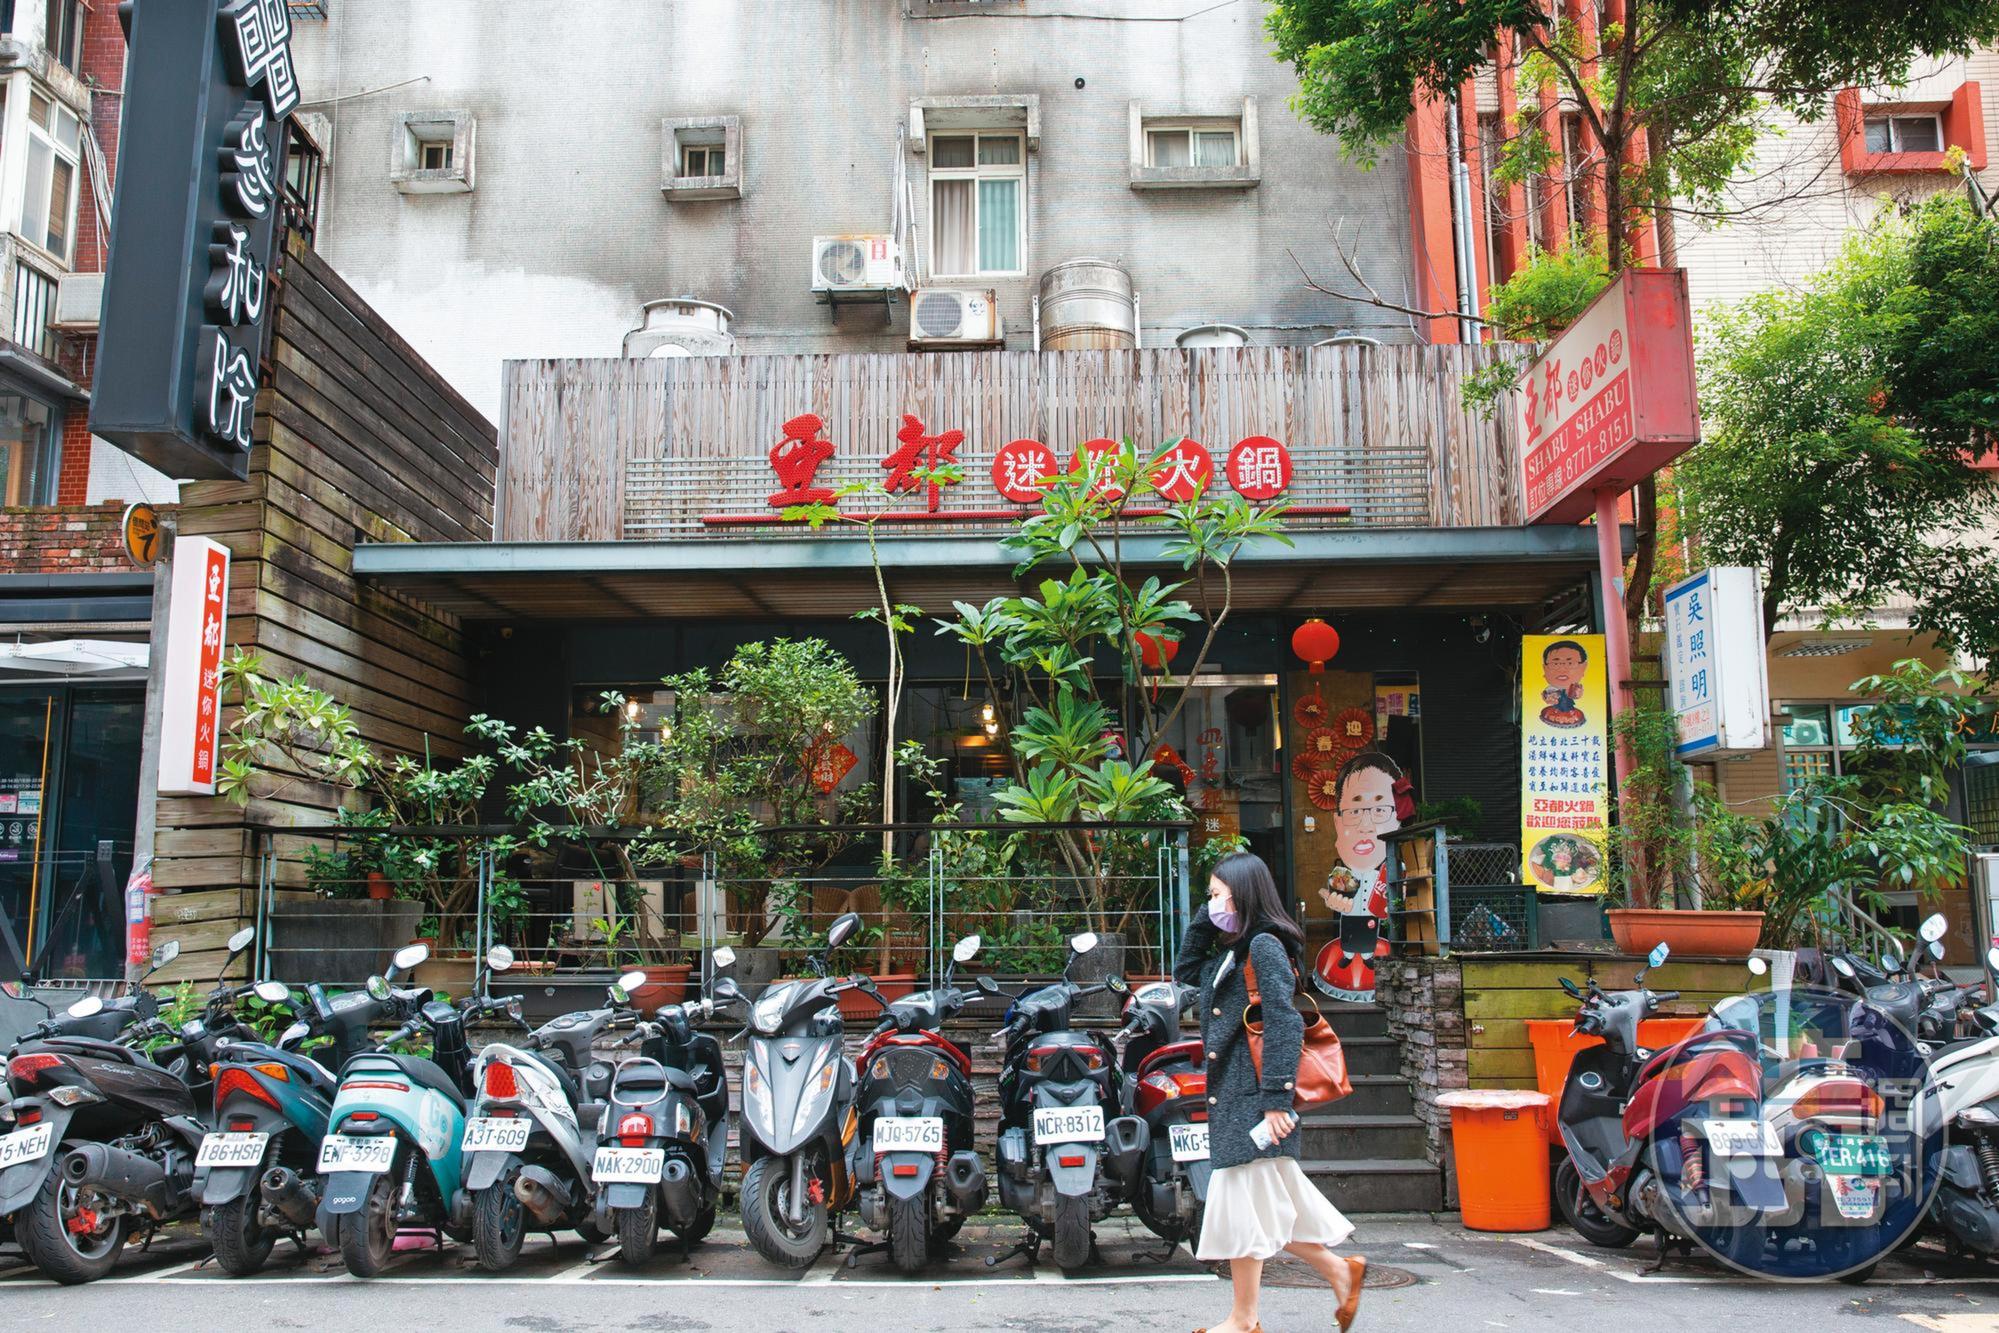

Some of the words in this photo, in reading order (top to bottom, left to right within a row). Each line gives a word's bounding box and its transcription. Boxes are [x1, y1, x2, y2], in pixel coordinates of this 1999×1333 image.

[1528, 427, 1570, 481] SHABU
[1575, 376, 1625, 440] SHABU
[1688, 592, 1707, 700] 吳照明
[1534, 799, 1595, 813] 亞都火鍋
[1205, 818, 1221, 832] 迷
[1037, 1115, 1102, 1136] NCR-8312
[465, 1129, 526, 1146] A3T-609
[876, 1126, 941, 1144] MJQ-5765
[201, 1144, 263, 1161] 186-HSR
[596, 1156, 660, 1175] NAK-2900
